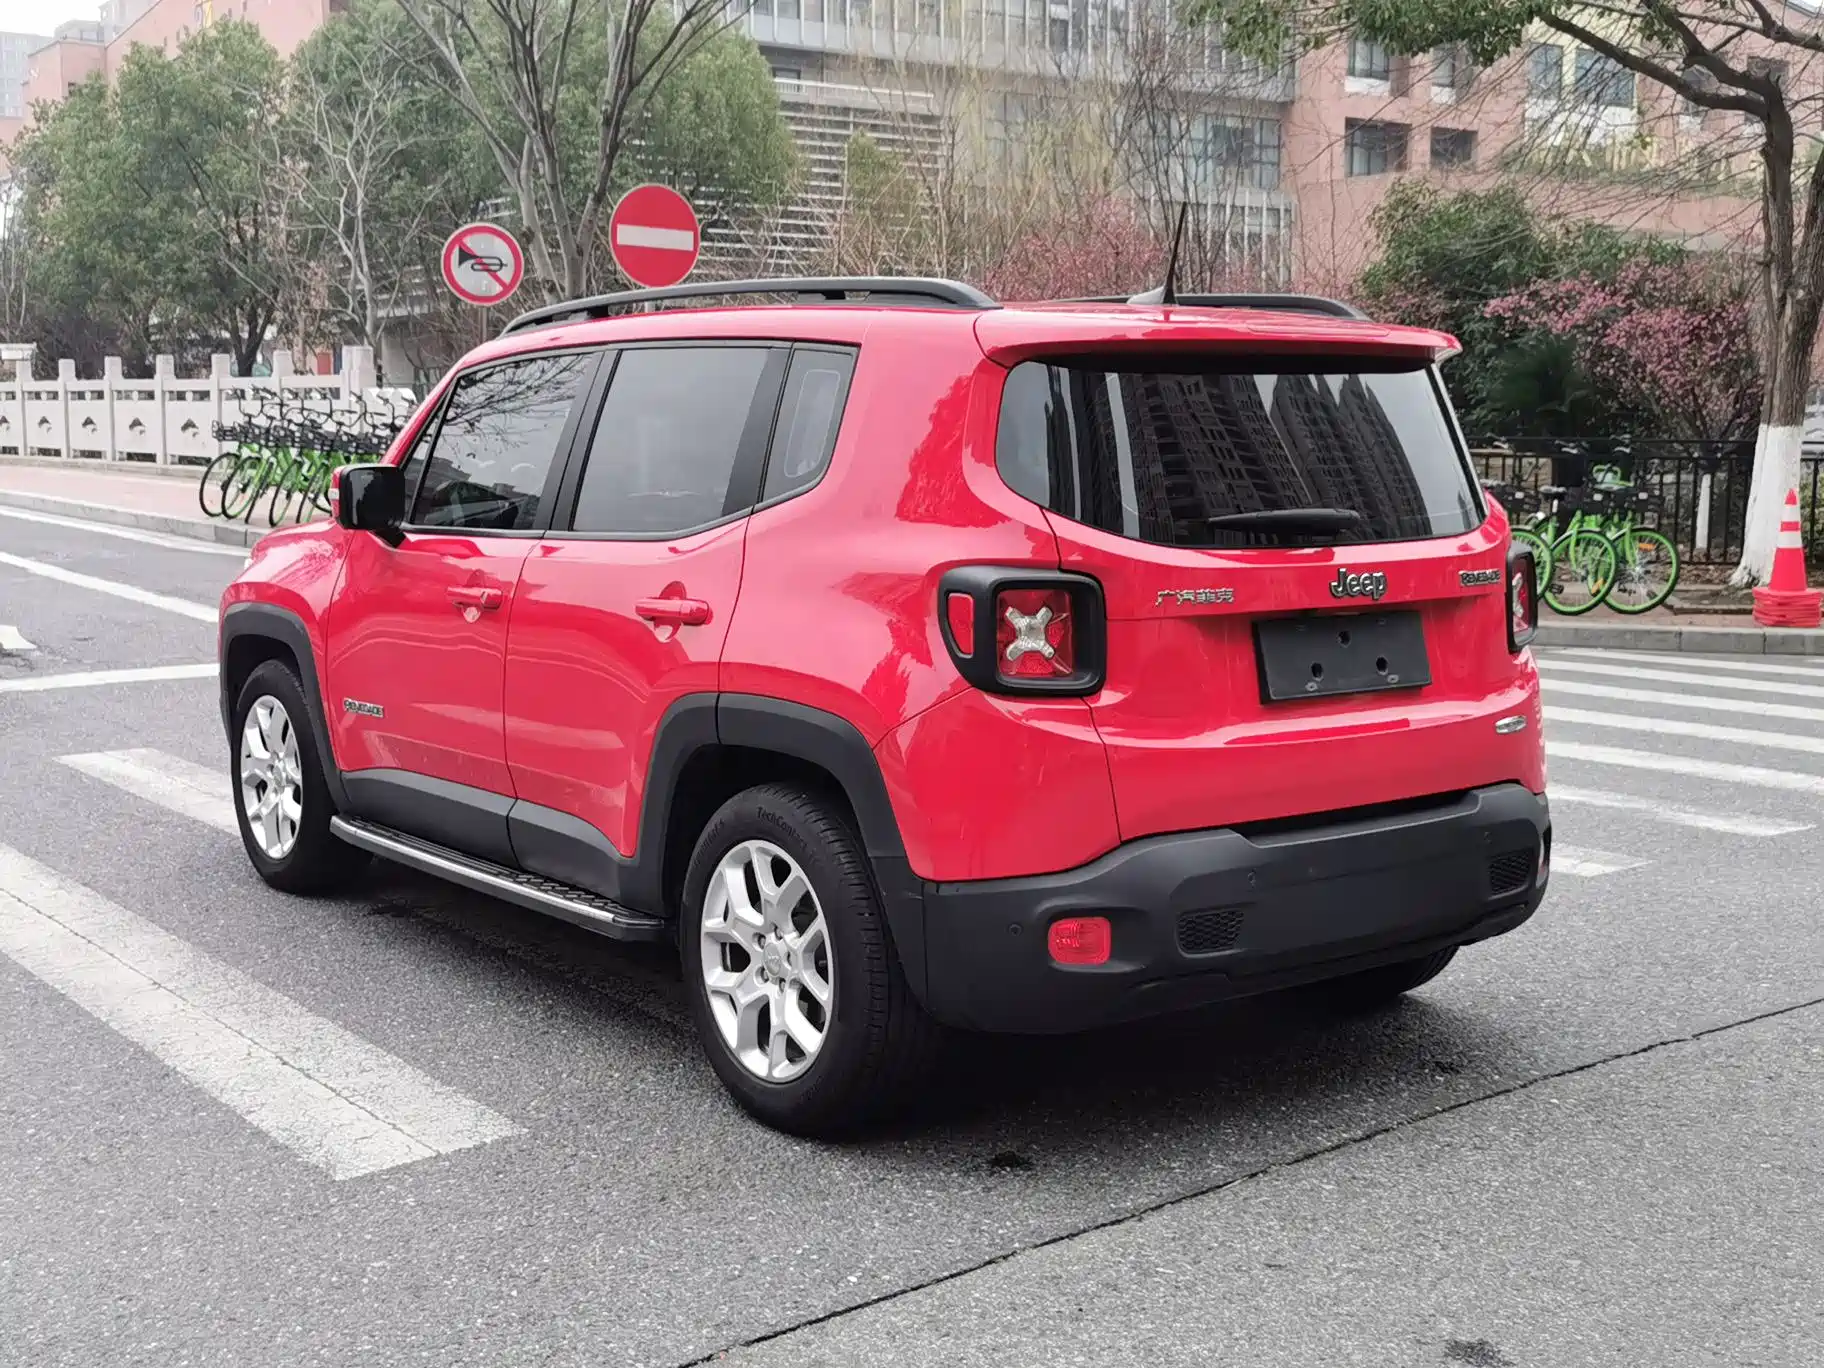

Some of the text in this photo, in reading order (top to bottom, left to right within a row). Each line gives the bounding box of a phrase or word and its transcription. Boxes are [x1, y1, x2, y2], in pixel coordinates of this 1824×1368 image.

[1329, 567, 1386, 600] Jeep
[1155, 587, 1234, 607] 广汽菲克
